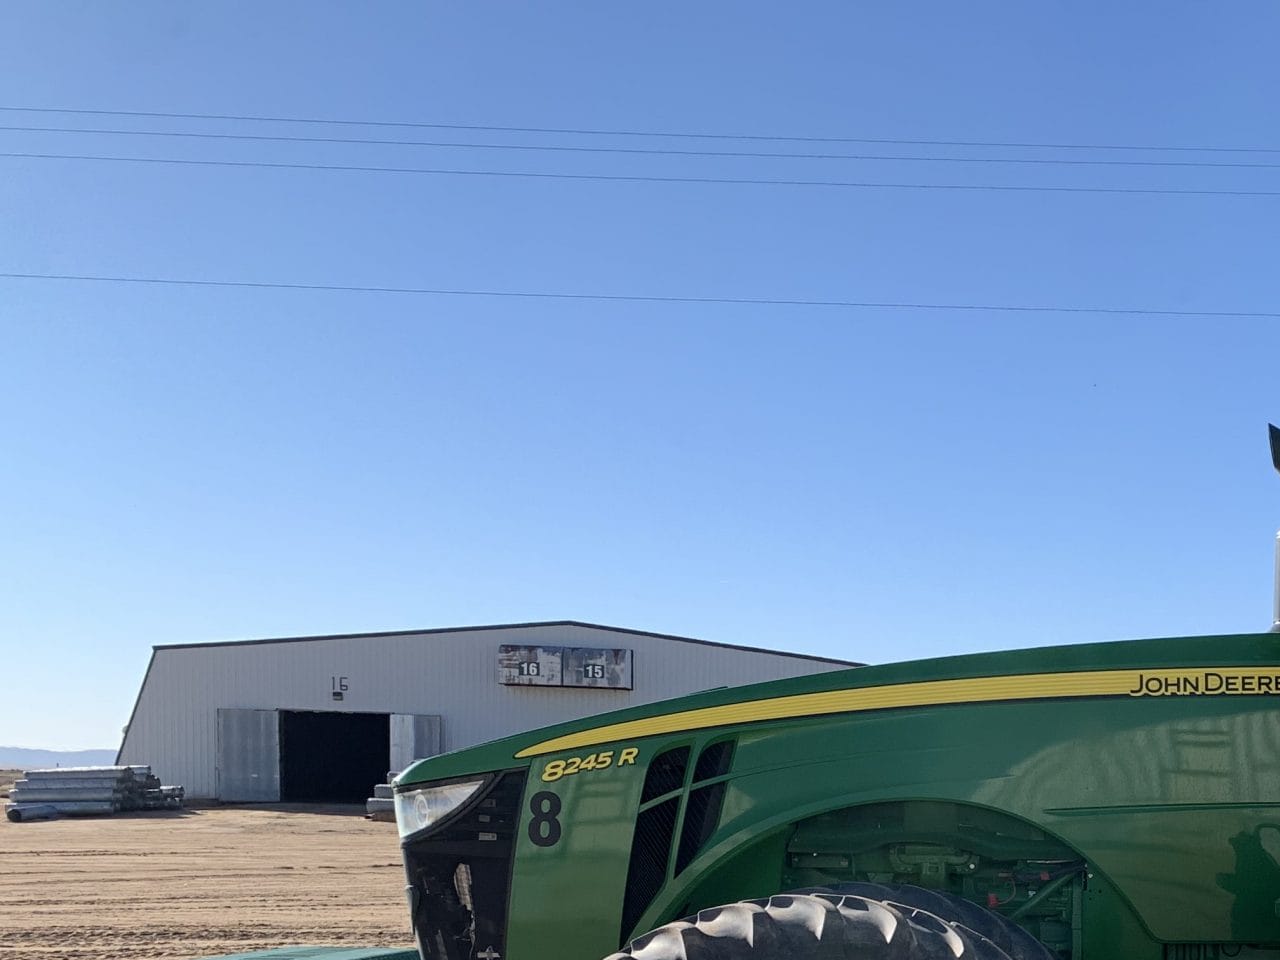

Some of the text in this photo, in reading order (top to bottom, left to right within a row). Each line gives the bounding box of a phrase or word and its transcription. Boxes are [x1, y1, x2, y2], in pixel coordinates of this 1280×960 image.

[521, 662, 538, 675] 16
[586, 665, 603, 677] 15
[332, 676, 348, 691] 16
[1130, 674, 1199, 694] JOHN
[541, 747, 639, 782] 8245 R
[528, 790, 562, 847] 8
